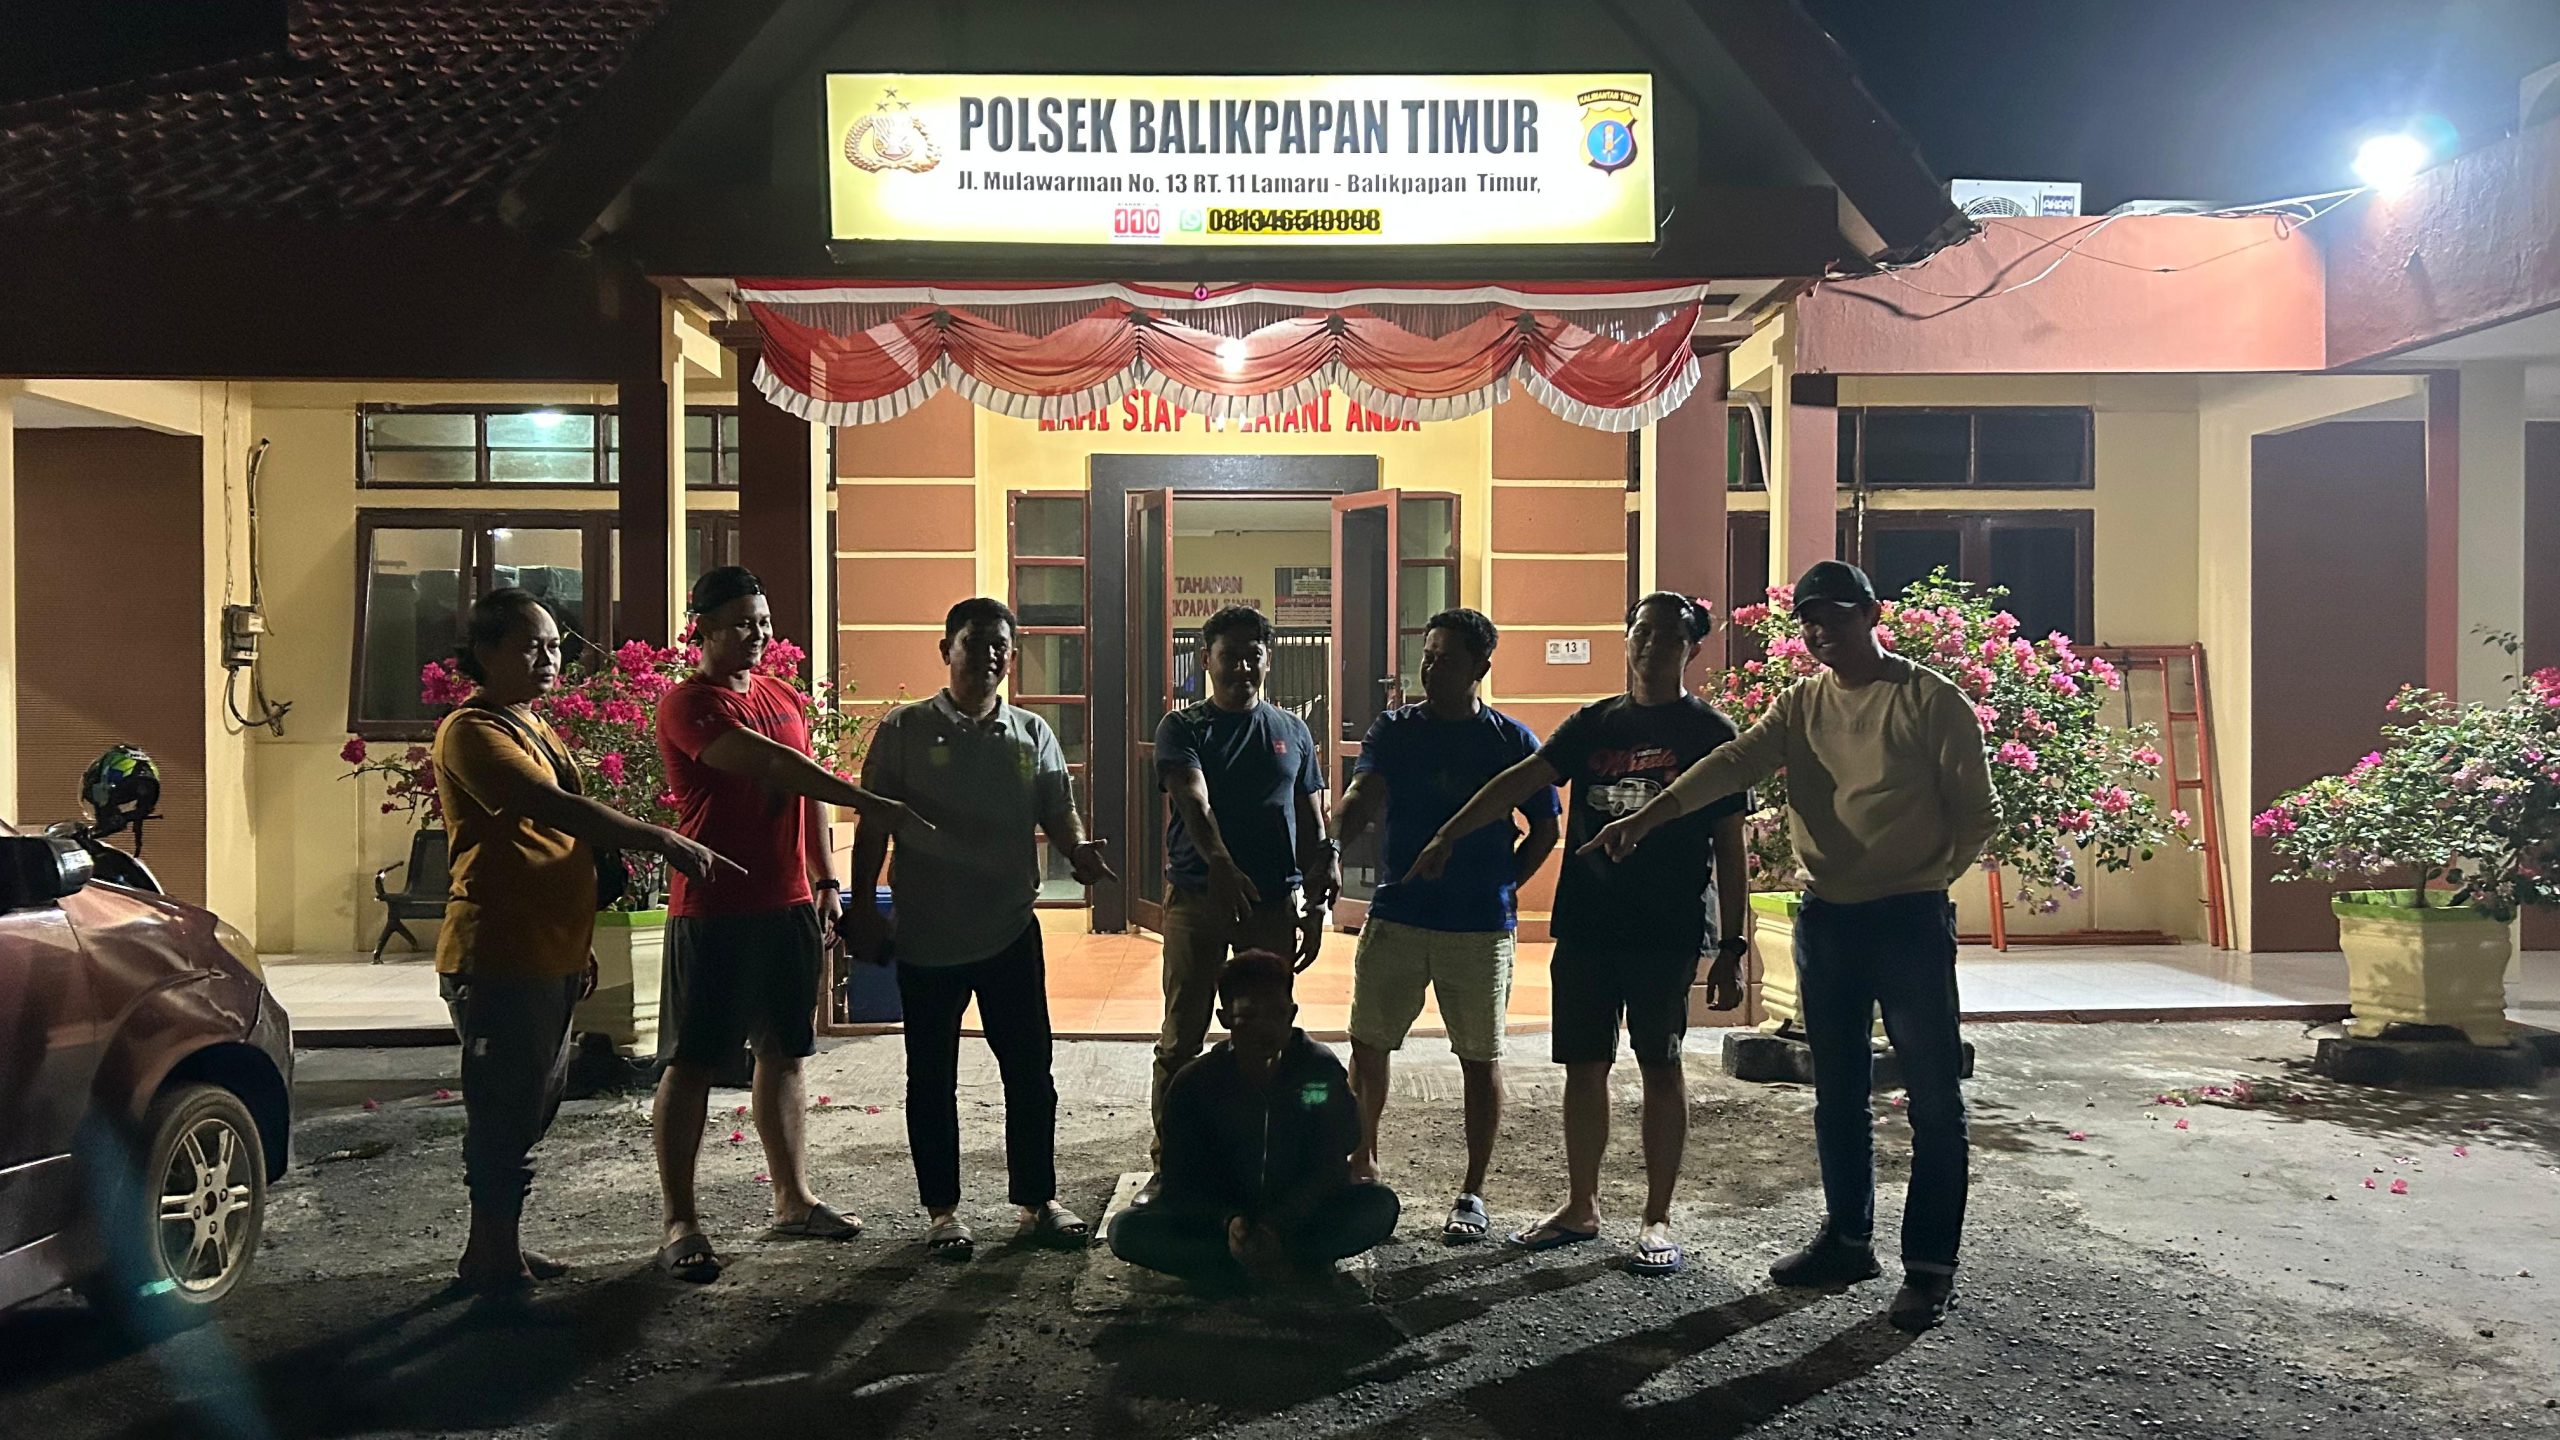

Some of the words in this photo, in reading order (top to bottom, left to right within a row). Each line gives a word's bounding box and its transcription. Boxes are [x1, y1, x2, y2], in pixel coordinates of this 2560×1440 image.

[959, 96, 1118, 154] POLSEK
[1130, 99, 1388, 154] BALIKPAPAN
[1401, 99, 1539, 154] TIMUR
[984, 171, 1122, 192] Mulawarman
[1128, 173, 1160, 193] No.
[1165, 174, 1188, 193] 13
[1193, 174, 1222, 193] RT.
[1226, 174, 1246, 193] 11
[1251, 174, 1329, 193] Lamaru
[1347, 174, 1467, 195] Balikpapan
[1476, 173, 1541, 194] Timur,
[1115, 209, 1160, 233] 110
[1175, 577, 1242, 593] TAHANAN
[1565, 642, 1577, 653] 13
